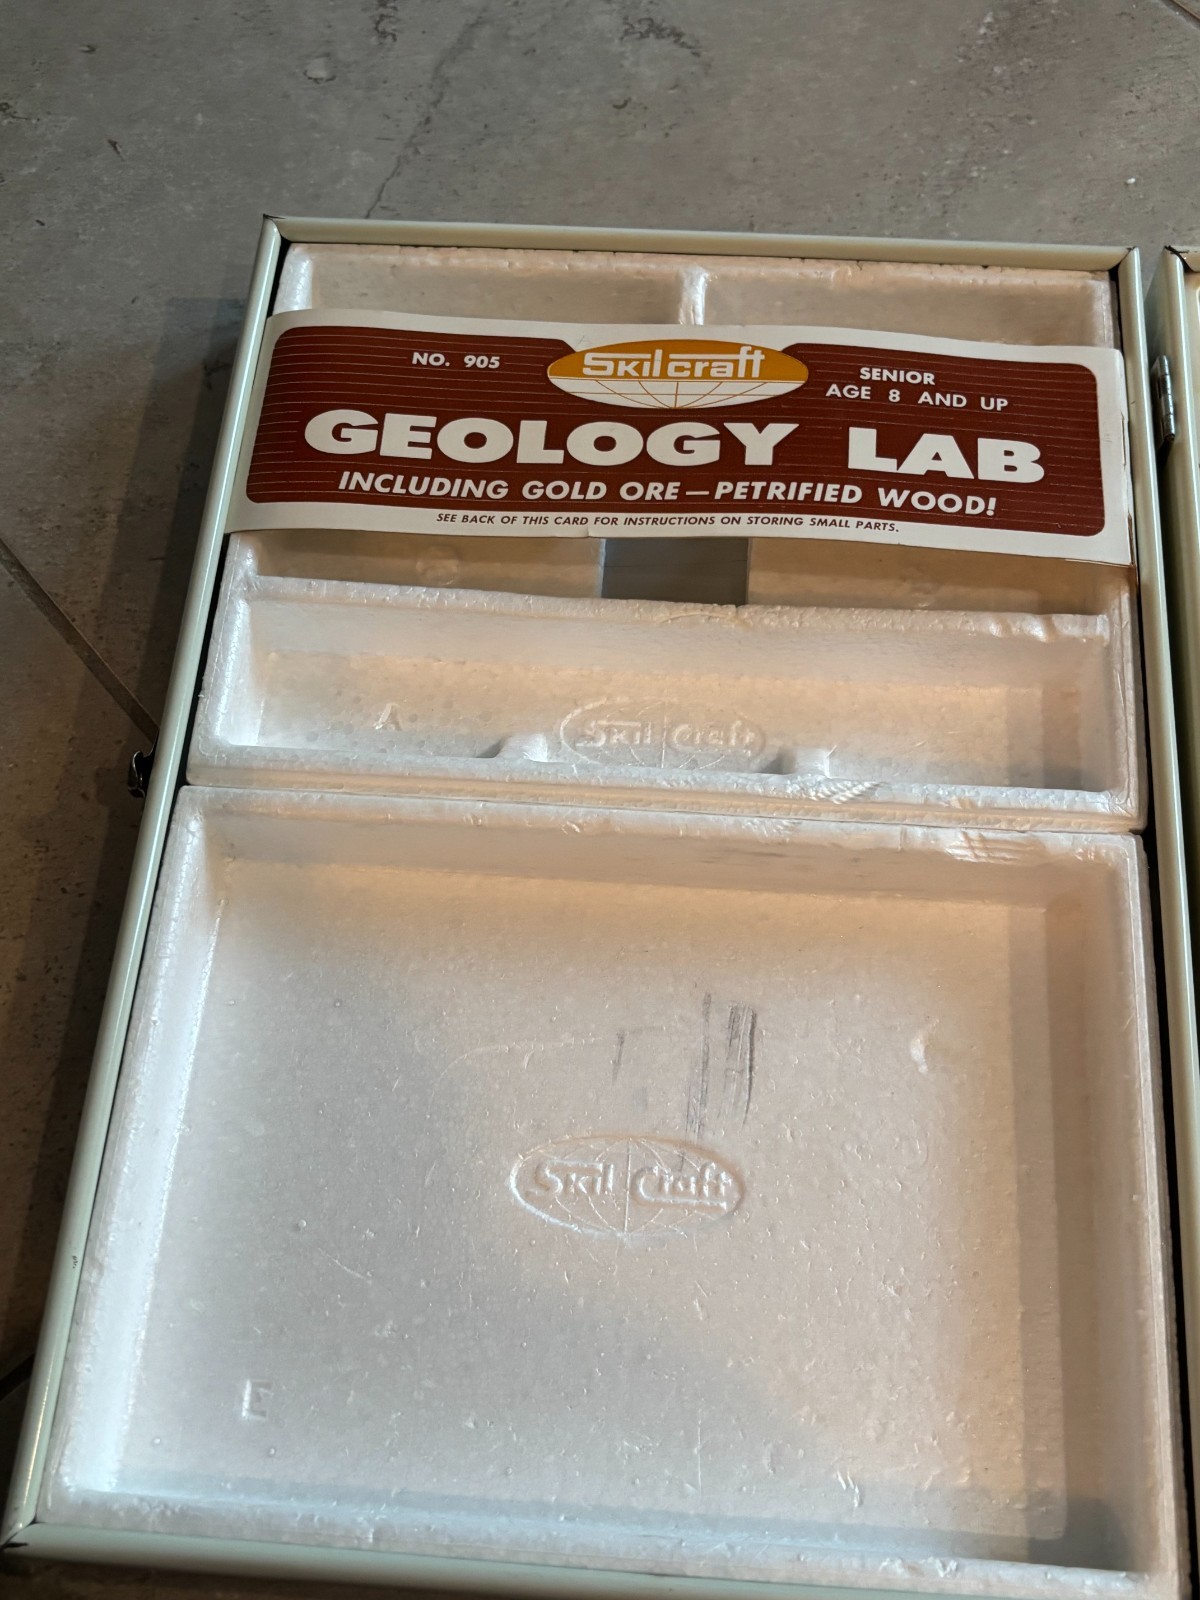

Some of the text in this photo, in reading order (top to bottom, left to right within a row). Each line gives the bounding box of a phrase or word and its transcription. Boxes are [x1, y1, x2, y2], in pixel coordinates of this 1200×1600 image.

[412, 351, 500, 369] NO. 905
[859, 366, 936, 386] SENIOR
[825, 383, 1009, 412] AGE 8 AND UP
[304, 409, 1045, 483] GEOLOGY LAB
[338, 471, 509, 500] INCLUDING
[521, 479, 607, 501] GOLD
[877, 487, 997, 516] WOOD!
[436, 513, 900, 533] SEE BACK OF THIS CARD FOR INSTRUCTIONS ON STORING SMALL PARTS.
